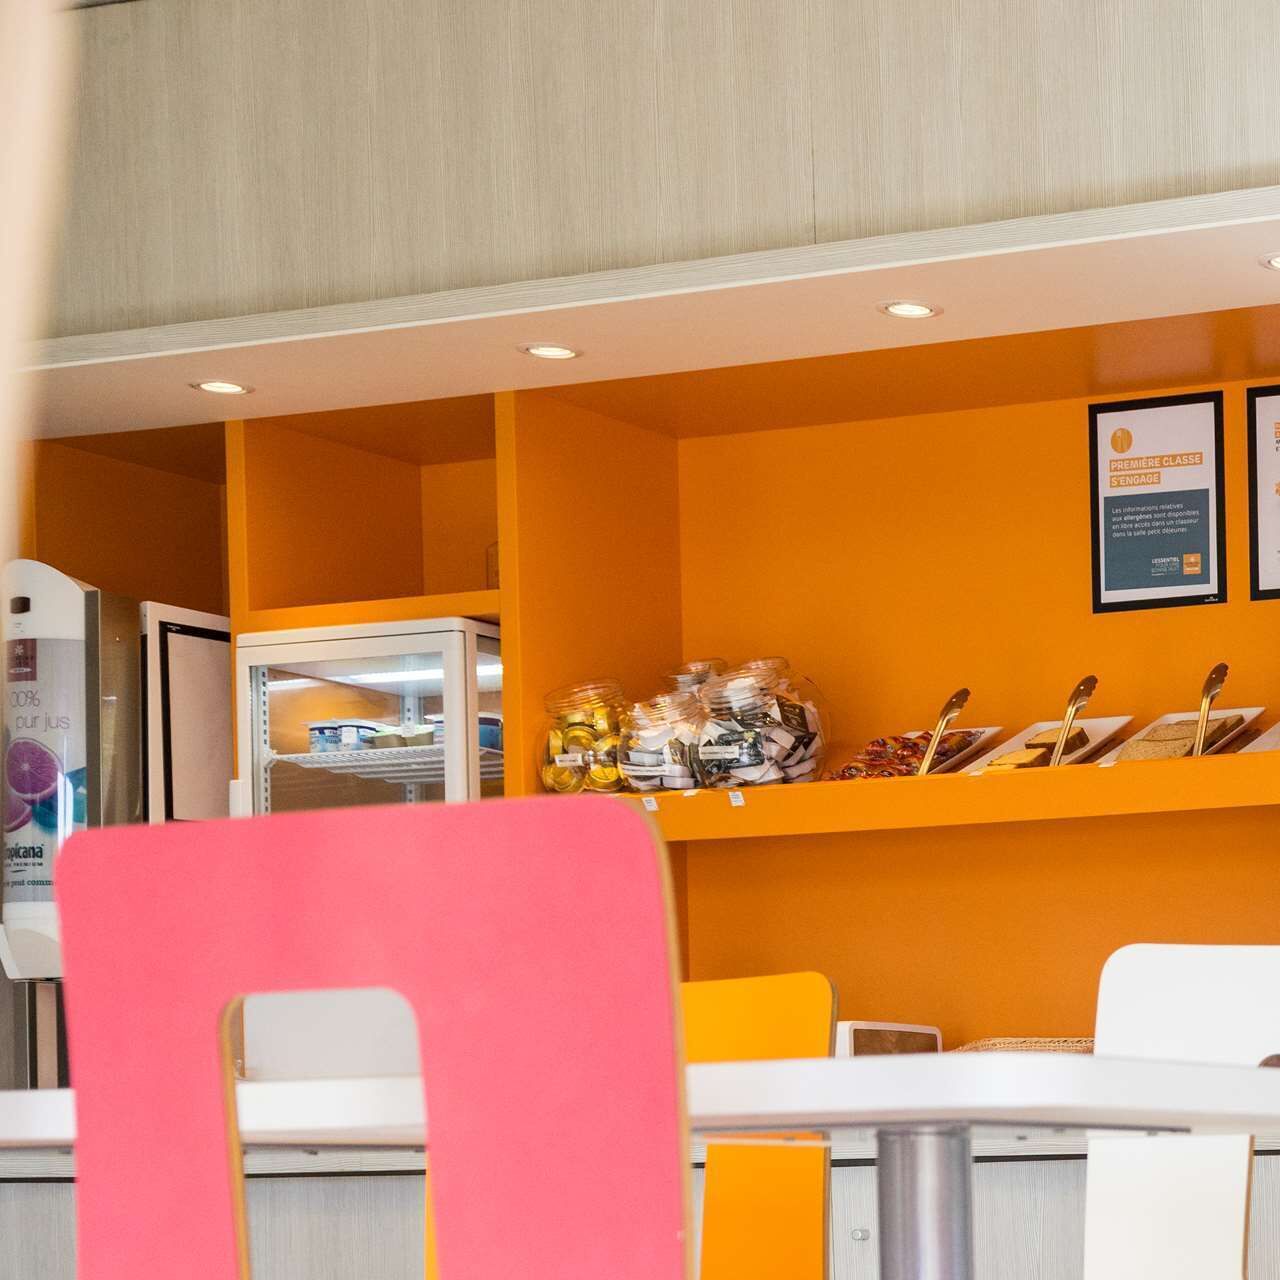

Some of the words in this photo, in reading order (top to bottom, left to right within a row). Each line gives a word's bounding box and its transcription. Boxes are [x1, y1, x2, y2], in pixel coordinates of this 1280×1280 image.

[1162, 454, 1201, 466] CLASSE
[1111, 473, 1160, 487] S'ENGAGE
[43, 711, 71, 733] jus
